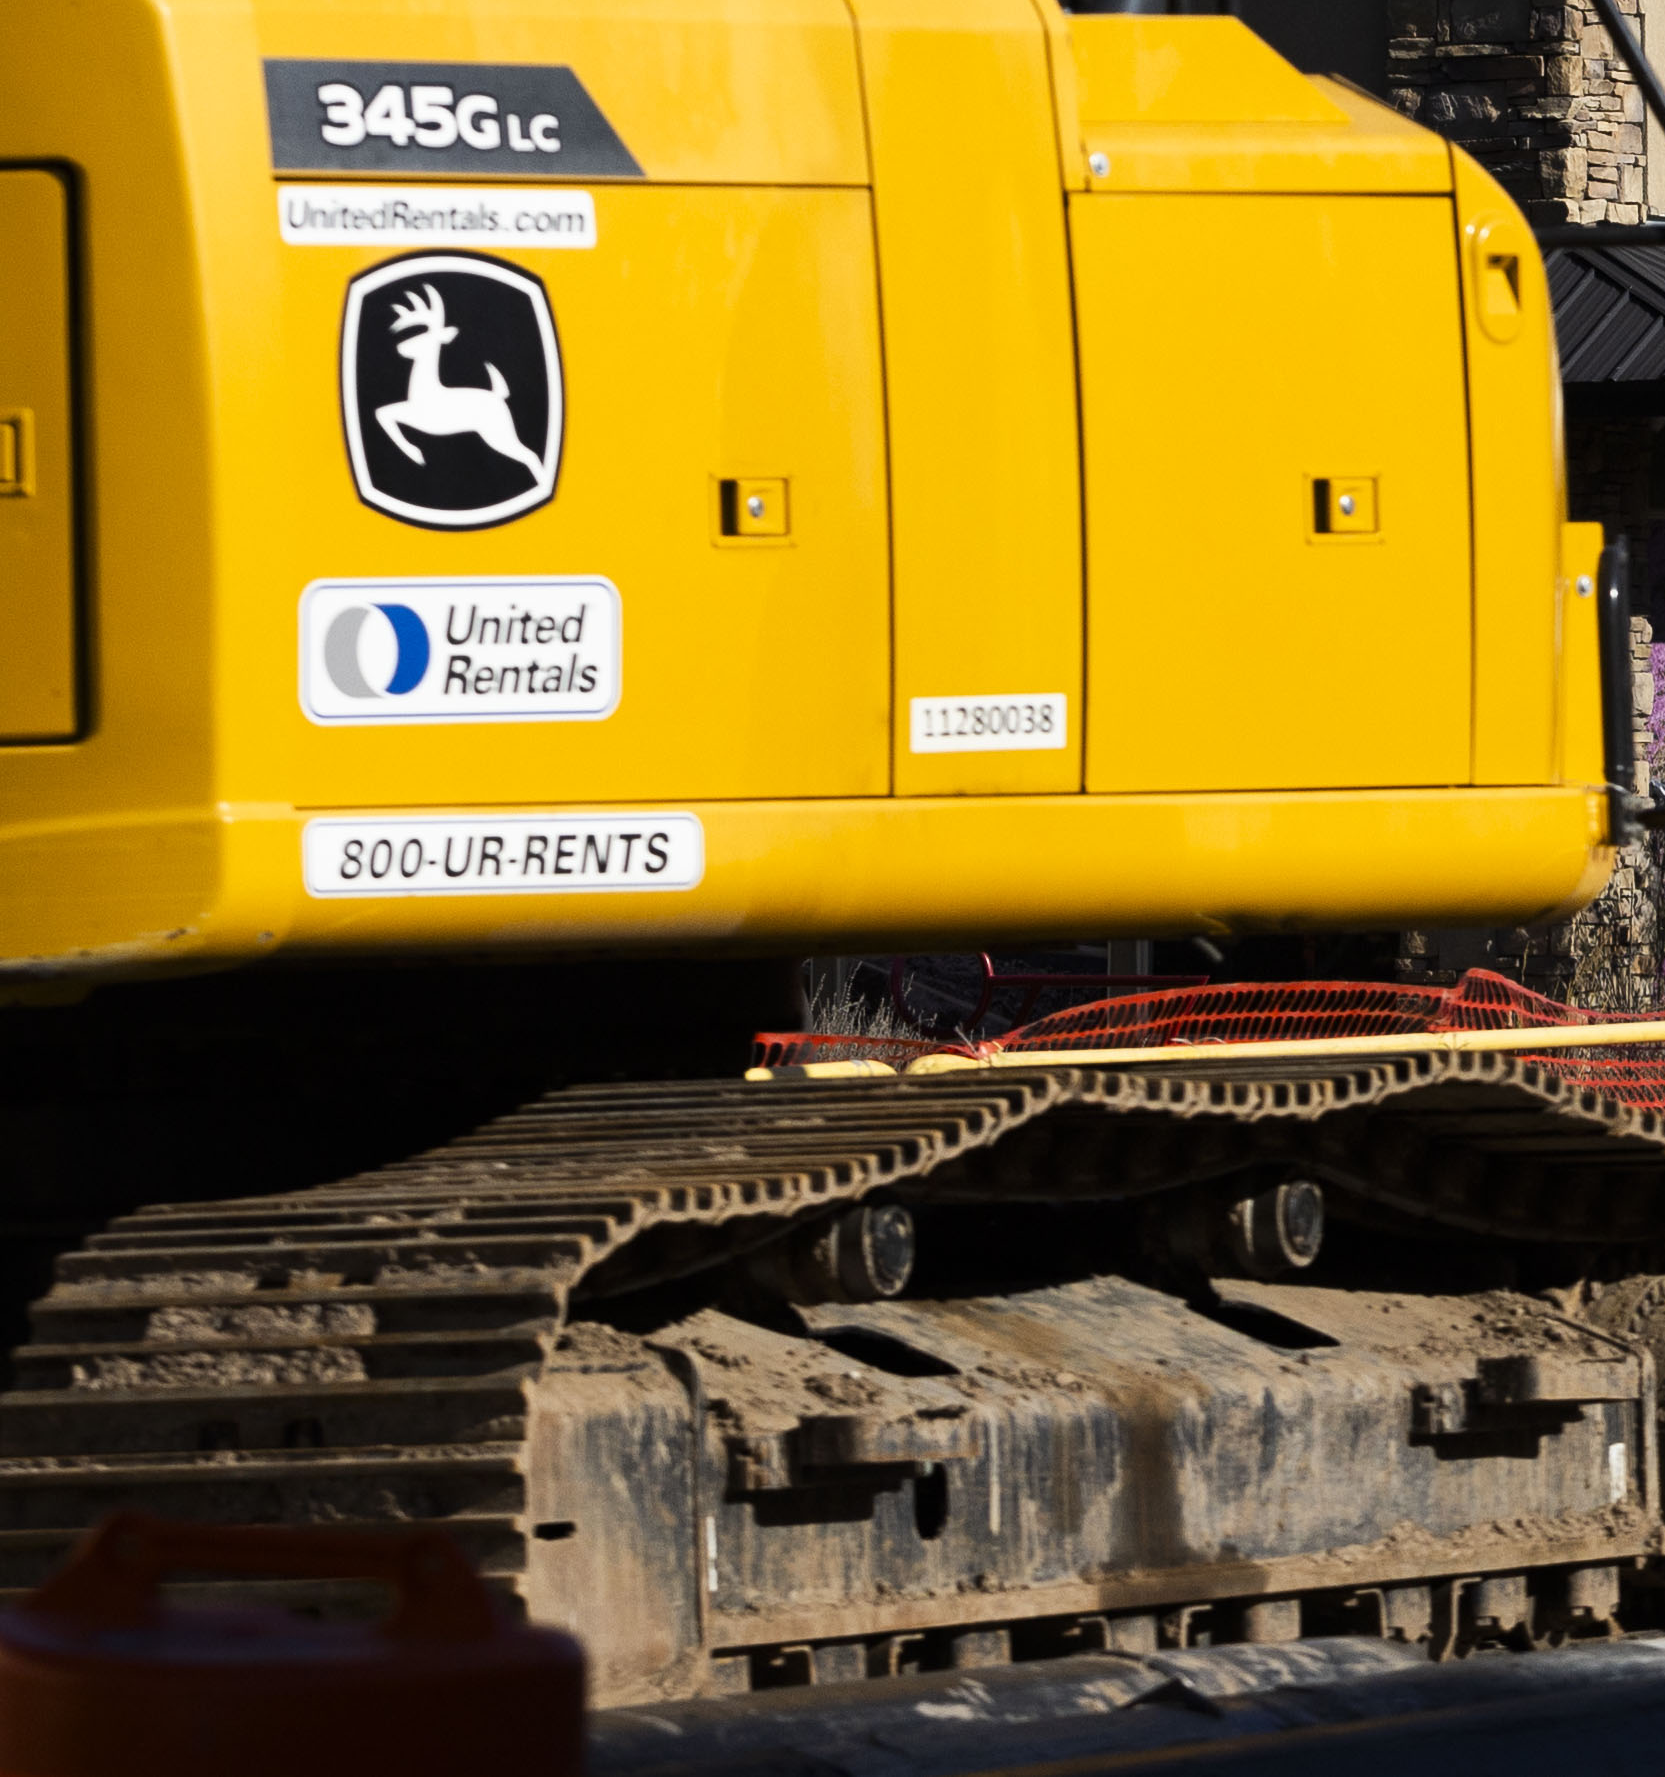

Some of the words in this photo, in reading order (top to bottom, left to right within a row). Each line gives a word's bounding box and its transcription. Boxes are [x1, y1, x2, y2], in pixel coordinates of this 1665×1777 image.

[318, 83, 500, 150] 345G
[507, 114, 562, 154] LC
[286, 197, 586, 236] UnitedRentals.com
[445, 603, 589, 645] United
[442, 654, 599, 696] Rentals
[922, 704, 1056, 738] 11280038
[338, 830, 671, 880] 800-UR-RENTS
